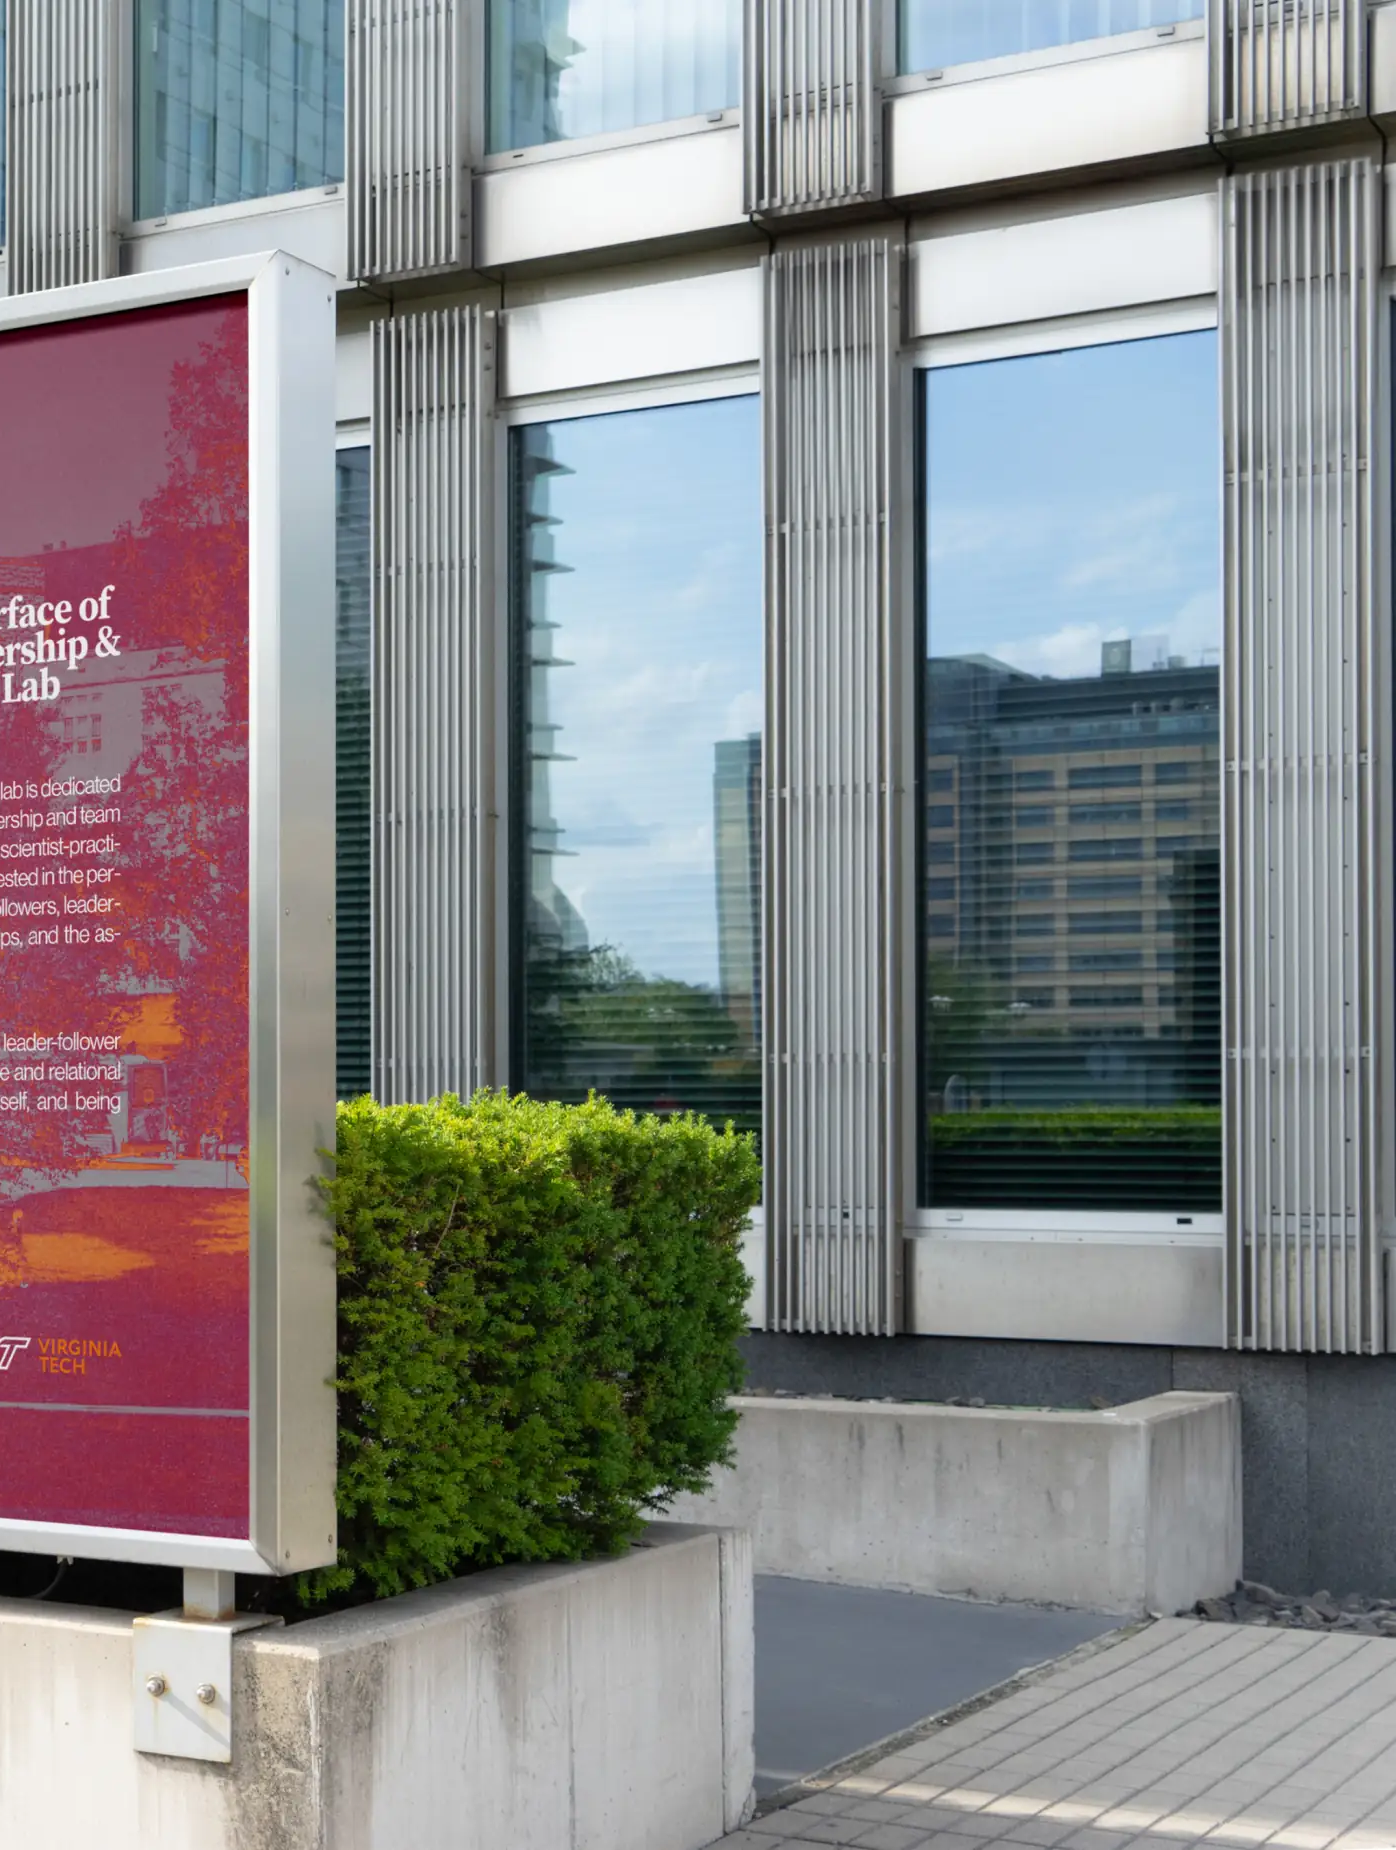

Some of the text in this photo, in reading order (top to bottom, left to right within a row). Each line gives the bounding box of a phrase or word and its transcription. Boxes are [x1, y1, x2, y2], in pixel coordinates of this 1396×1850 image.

[79, 584, 115, 621] of
[94, 625, 121, 659] &
[2, 668, 61, 704] Lab
[0, 781, 23, 800] lab
[26, 780, 38, 798] is
[41, 774, 121, 797] dedicated
[46, 807, 76, 826] and
[80, 807, 120, 824] team
[0, 834, 121, 859] scientist-practi-
[42, 867, 55, 885] in
[58, 866, 83, 884] the
[87, 865, 121, 887] per-
[64, 894, 121, 914] leader-
[29, 925, 59, 945] and
[64, 925, 89, 943] the
[95, 925, 121, 941] as-
[4, 1032, 120, 1052] leader-follower
[14, 1063, 44, 1081] and
[49, 1062, 121, 1080] relational
[37, 1092, 67, 1110] and
[76, 1092, 121, 1114] being
[38, 1338, 122, 1357] VIRGINIA
[38, 1357, 86, 1375] TECH
